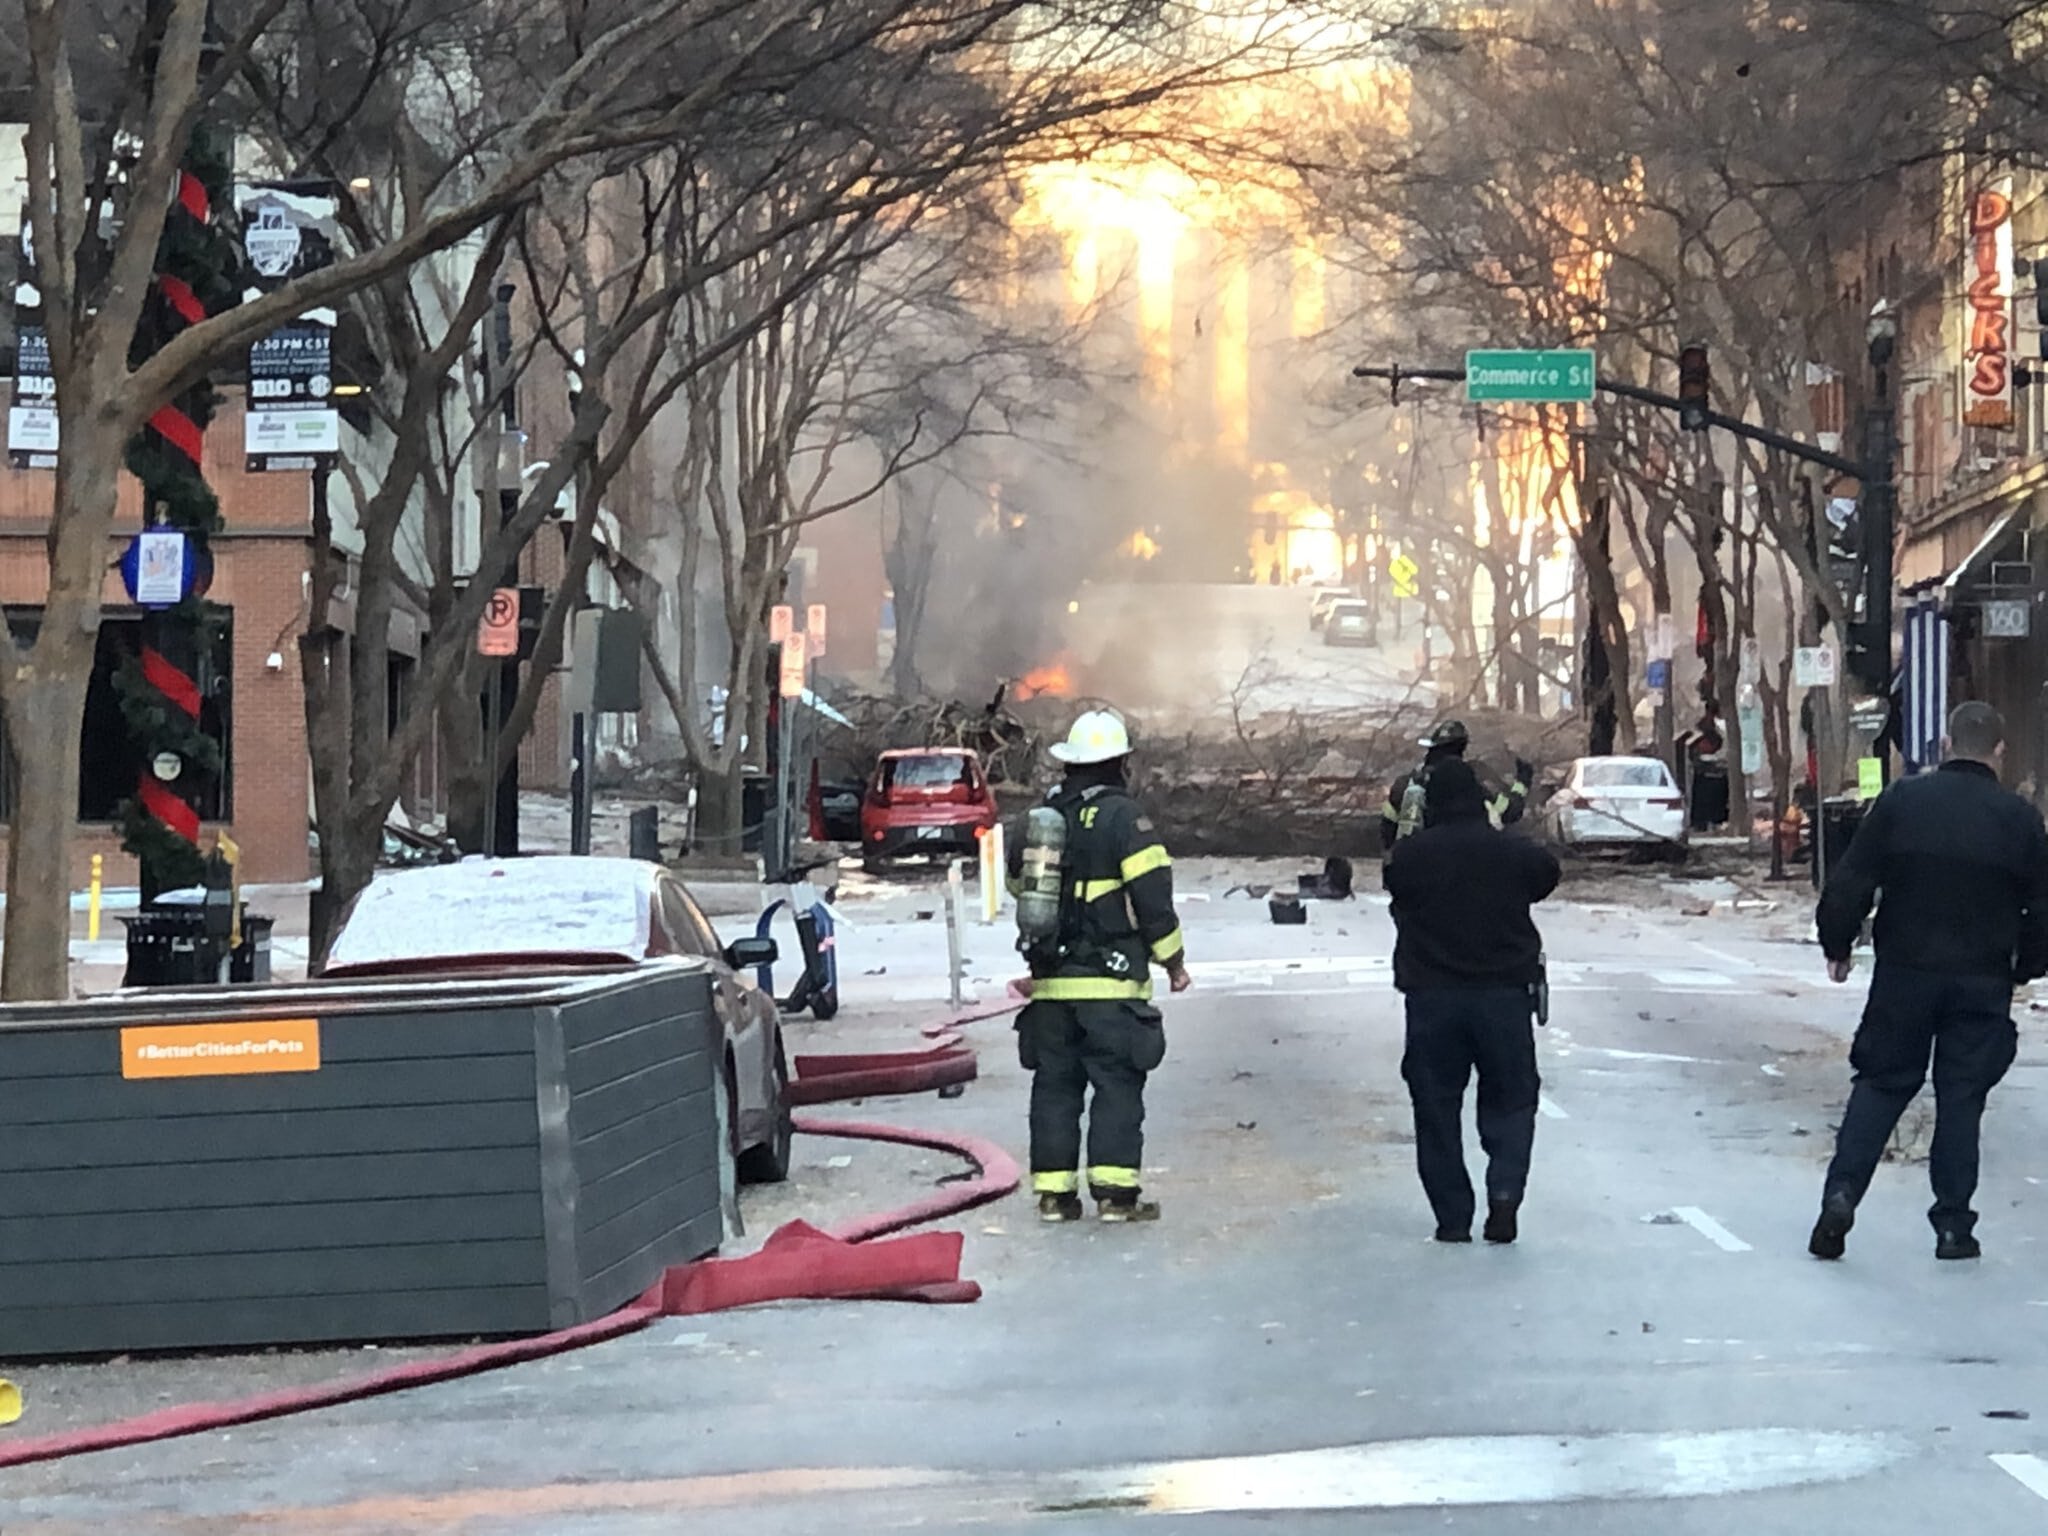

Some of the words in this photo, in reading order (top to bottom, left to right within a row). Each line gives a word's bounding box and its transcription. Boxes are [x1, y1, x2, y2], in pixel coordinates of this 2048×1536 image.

[1469, 366, 1559, 386] Commerce
[1568, 365, 1591, 386] St
[1990, 607, 2024, 632] 160
[137, 1039, 304, 1059] #BetterCitiesForPets
